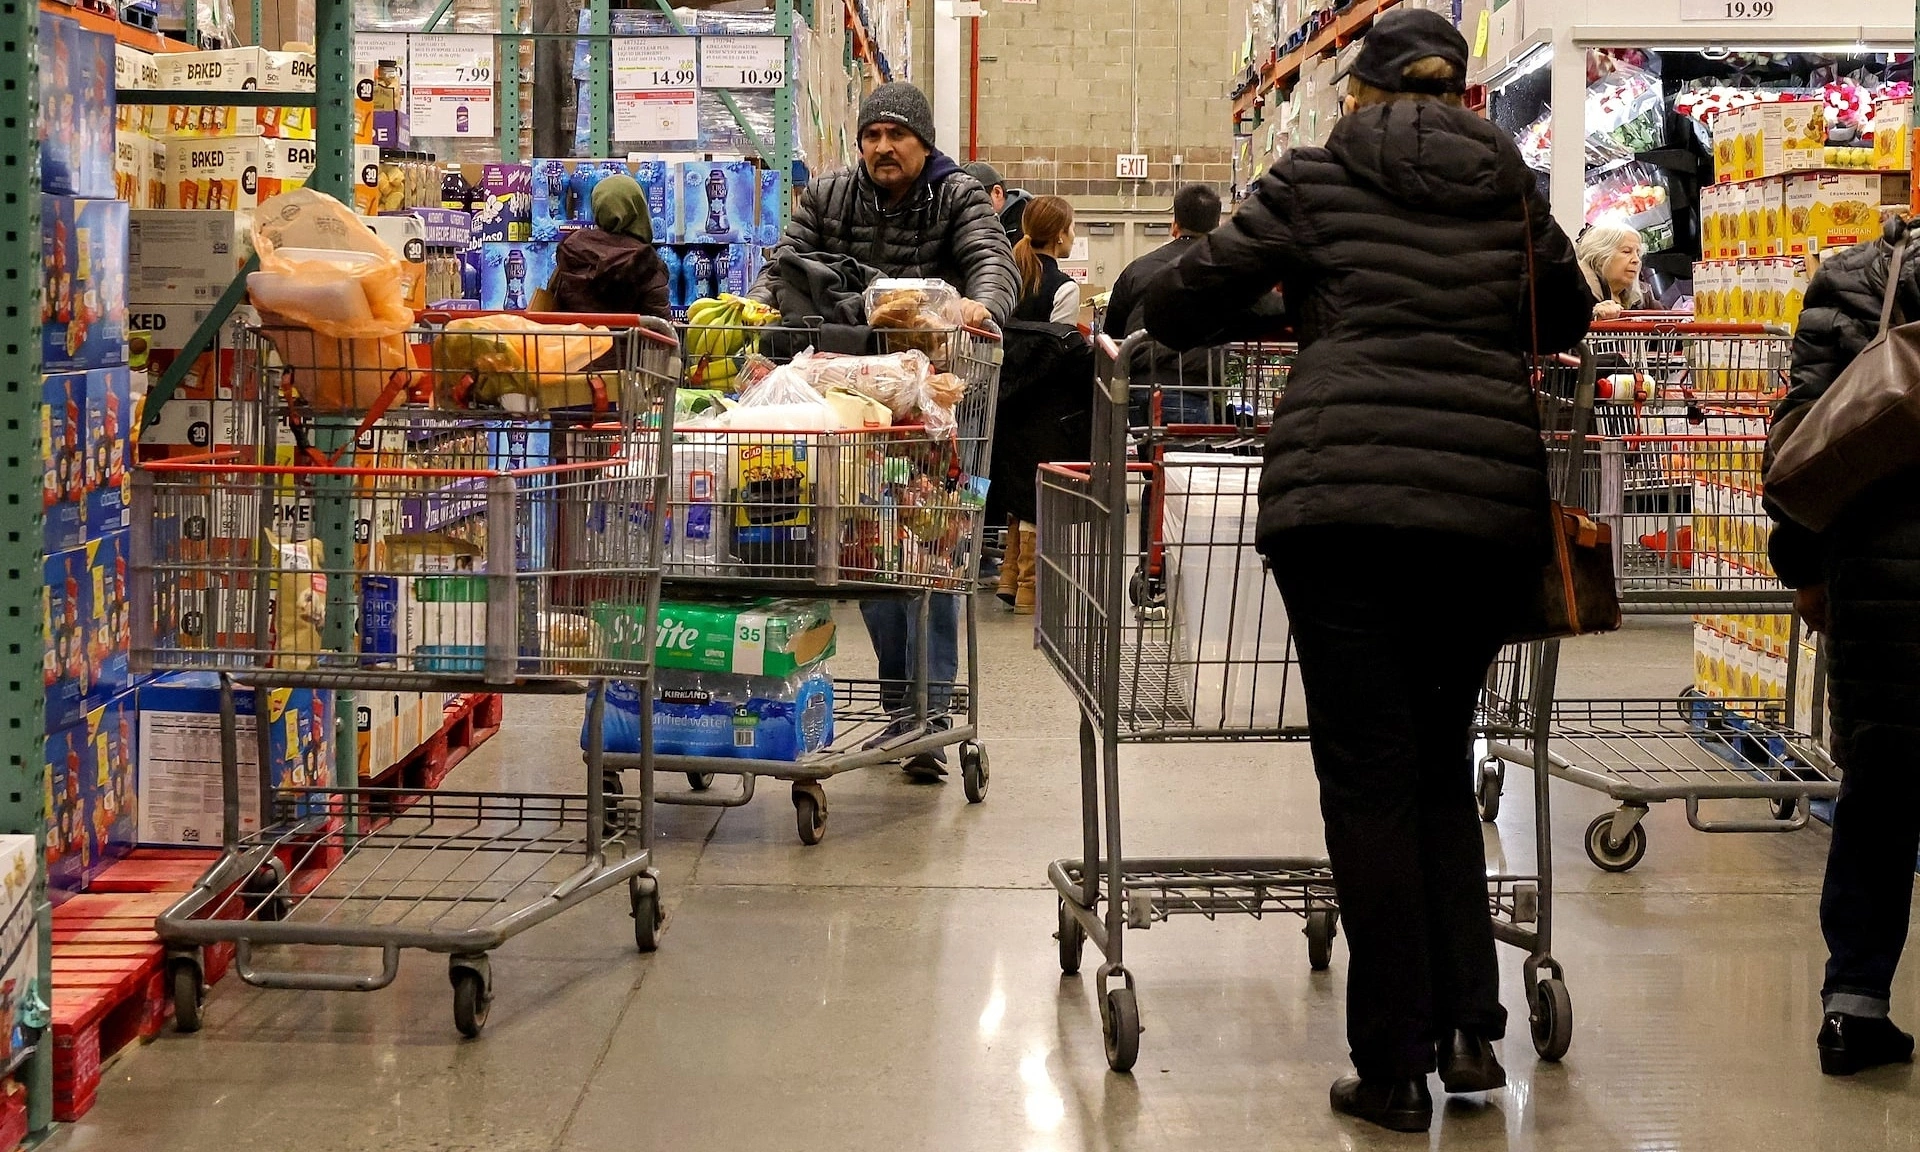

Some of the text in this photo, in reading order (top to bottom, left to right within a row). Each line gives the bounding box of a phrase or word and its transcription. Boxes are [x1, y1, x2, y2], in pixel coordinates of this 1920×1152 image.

[1725, 1, 1773, 18] 19.99
[187, 62, 222, 80] BAKED
[456, 67, 490, 82] 7.99
[652, 70, 695, 86] 14.99
[741, 69, 783, 85] 10.99
[360, 83, 372, 94] 30
[191, 150, 224, 168] BAKED
[1121, 158, 1145, 175] EXIT
[245, 172, 256, 184] 30
[365, 169, 377, 180] 30
[409, 242, 422, 254] 30
[129, 313, 166, 331] KED
[192, 426, 206, 438] 30
[609, 614, 699, 649] Spite
[739, 626, 760, 642] 35
[664, 690, 708, 701] KIRKLAND
[357, 712, 368, 723] 30
[652, 714, 688, 728] urified
[688, 714, 727, 729] water
